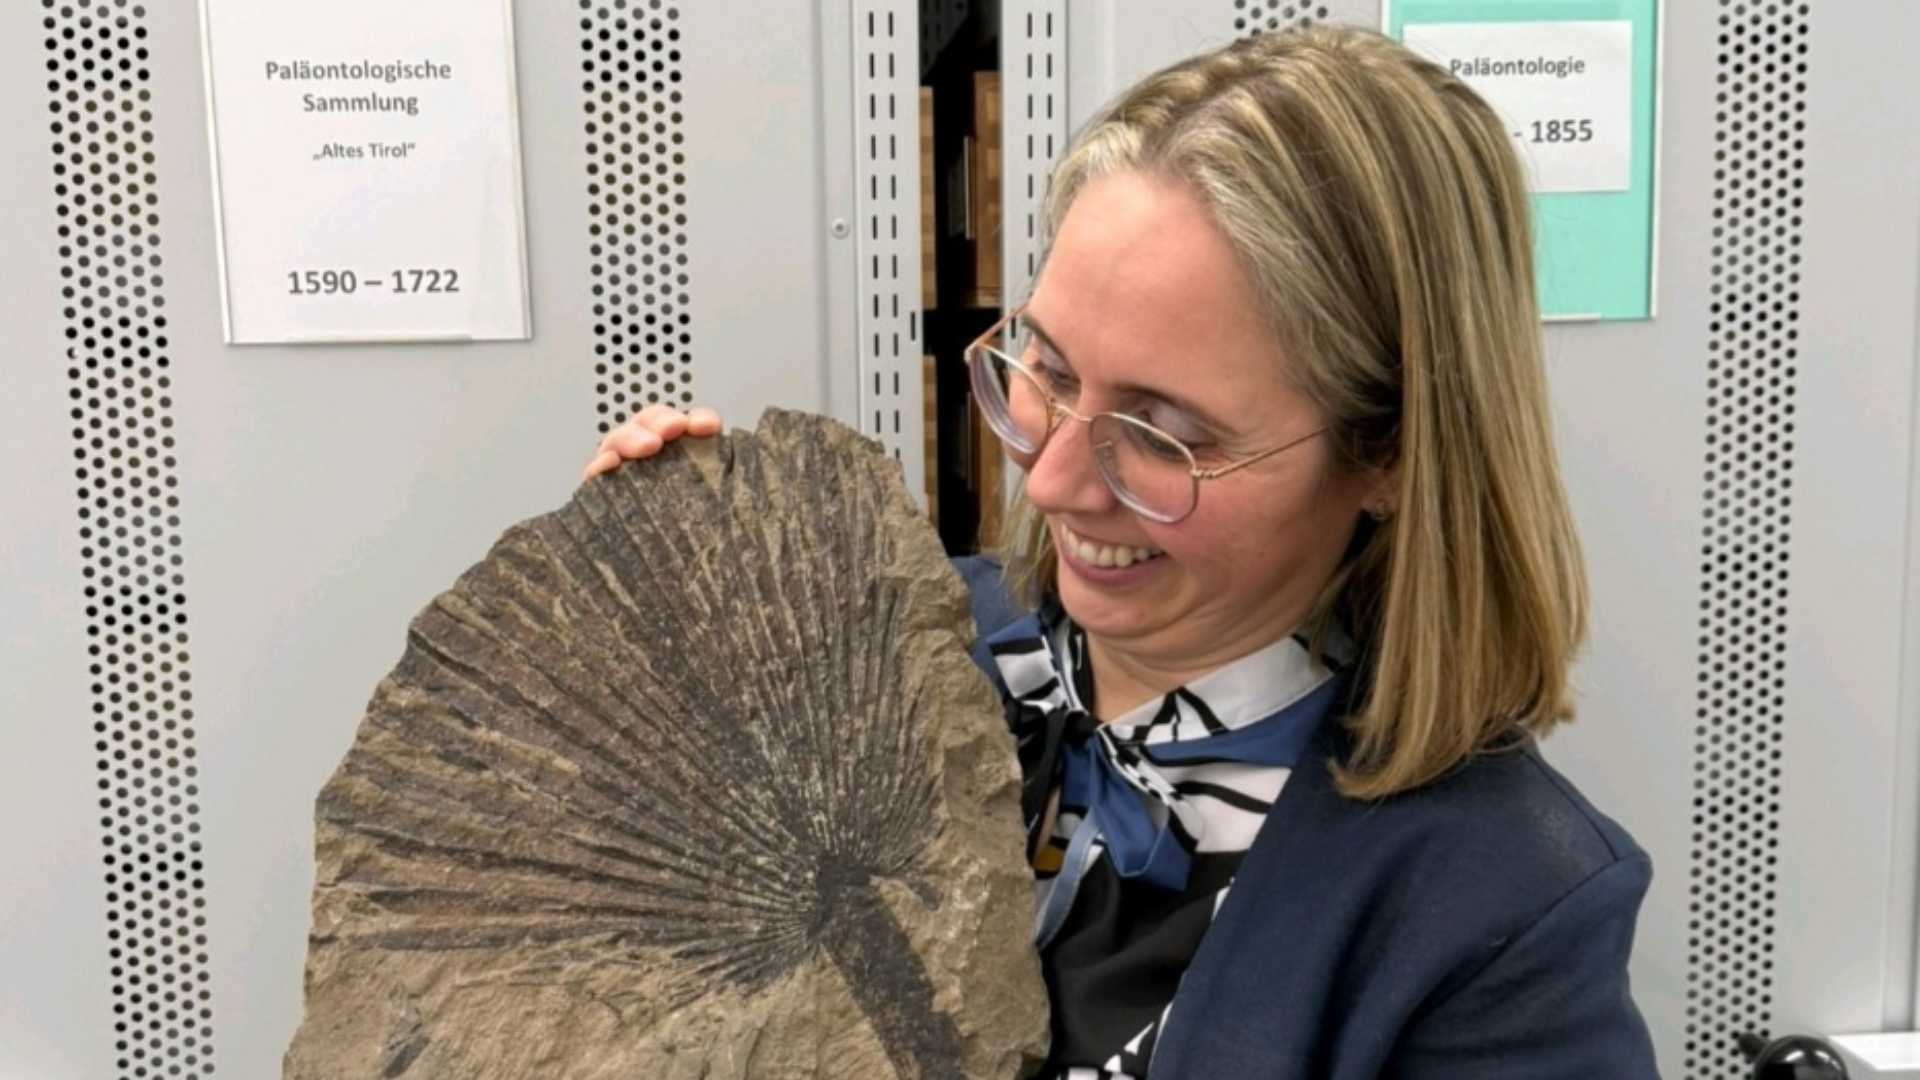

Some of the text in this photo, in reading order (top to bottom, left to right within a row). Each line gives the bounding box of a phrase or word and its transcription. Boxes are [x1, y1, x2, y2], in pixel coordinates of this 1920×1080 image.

[265, 60, 452, 83] Paläontologische
[1449, 56, 1586, 78] Paläontologie
[302, 92, 419, 115] Sammlung
[1531, 119, 1593, 143] 1855
[287, 270, 357, 294] 1590
[391, 269, 460, 293] 1722
